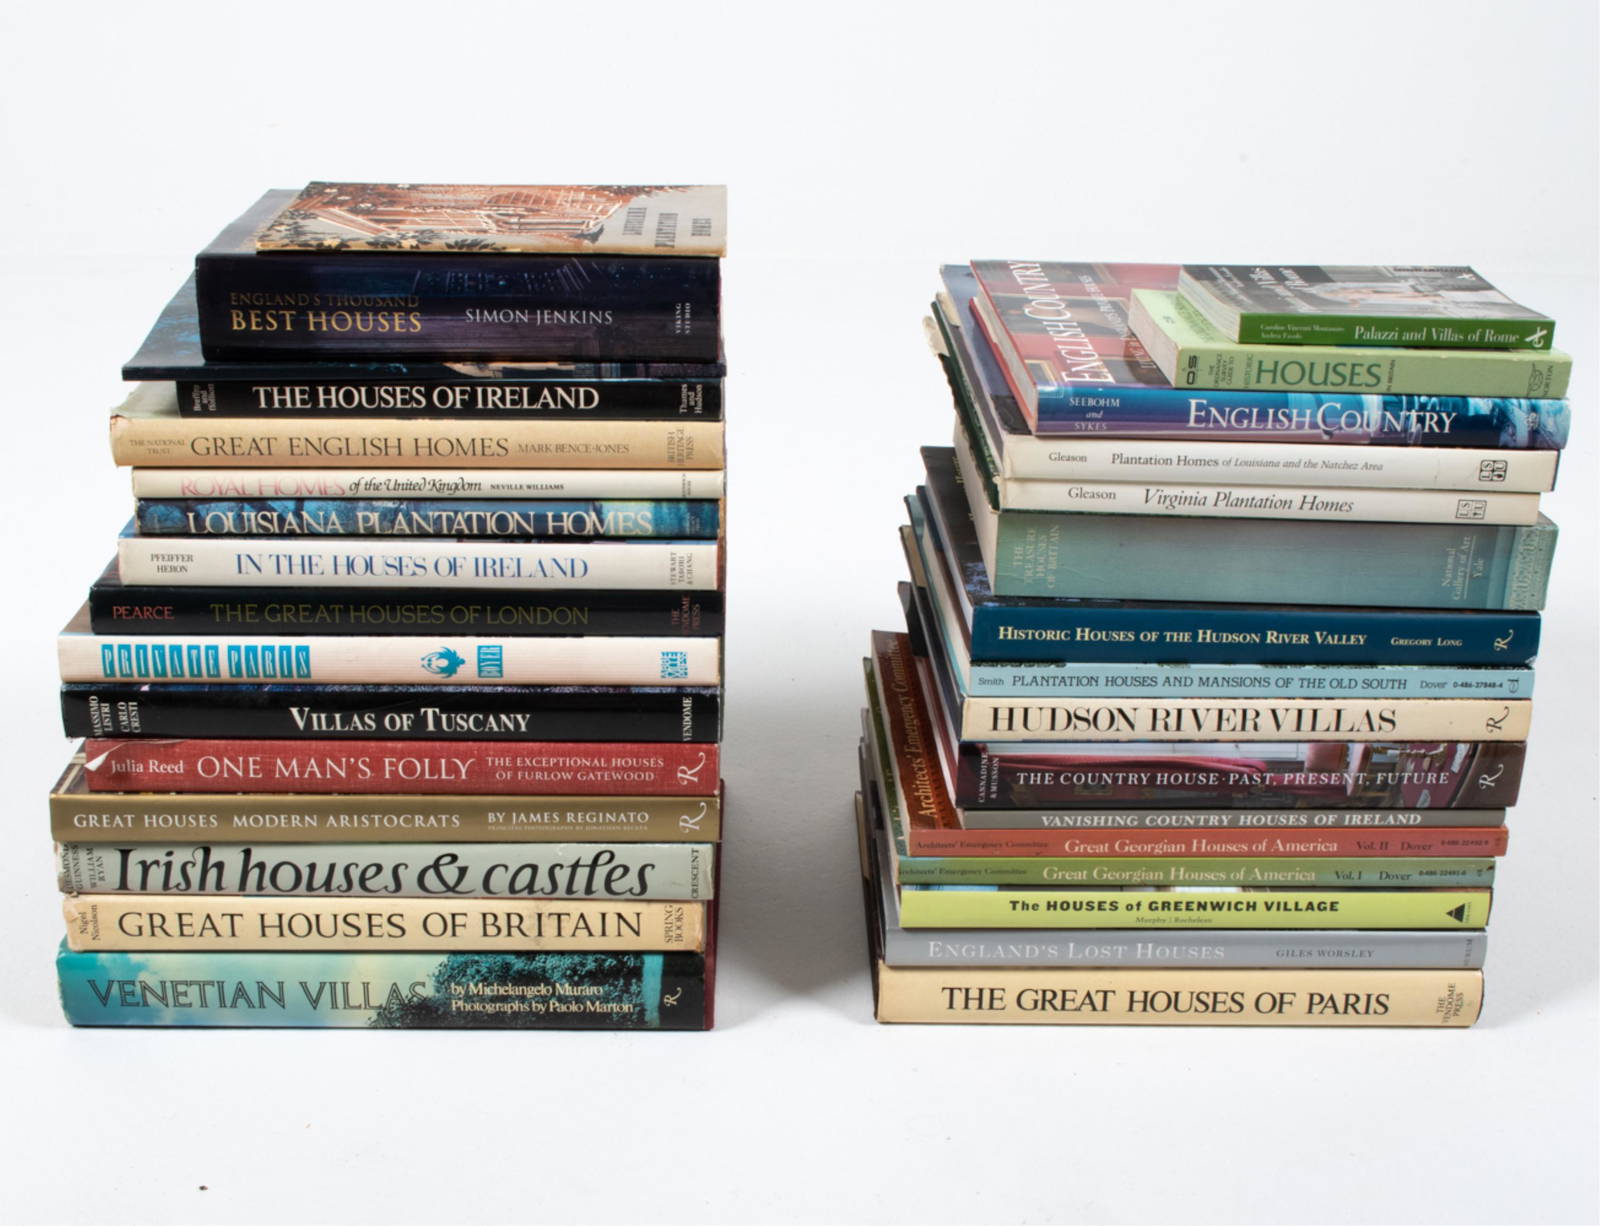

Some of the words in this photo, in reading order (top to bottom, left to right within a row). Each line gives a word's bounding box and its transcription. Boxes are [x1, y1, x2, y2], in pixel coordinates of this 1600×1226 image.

[230, 310, 297, 332] BEST
[307, 311, 422, 333] HOUSES
[465, 309, 529, 324] SIMON
[536, 310, 613, 326] JENKINS
[1354, 326, 1399, 341] Palazzi
[1402, 327, 1427, 342] and
[1431, 328, 1465, 343] Villas
[1467, 328, 1481, 343] of
[1484, 329, 1520, 344] Rome
[1255, 359, 1382, 388] HOUSES
[252, 386, 313, 409] THE
[316, 386, 427, 410] HOUSES
[432, 386, 471, 409] OF
[476, 386, 600, 410] IRELAND
[1068, 397, 1120, 408] SEEBOHM
[1086, 410, 1103, 419] and
[1187, 398, 1312, 431] ENGLISH
[1316, 402, 1457, 434] COUNTRY
[1074, 421, 1108, 431] SYKES
[191, 437, 277, 457] GREAT
[289, 437, 402, 457] ENGLISH
[413, 437, 509, 457] HOMES
[518, 443, 552, 454] MARK
[554, 443, 630, 455] BENCE-JONES
[1048, 451, 1087, 464] Gleason
[1111, 452, 1173, 466] Plantation
[1176, 454, 1220, 468] Homes
[1222, 457, 1233, 468] of
[1234, 457, 1280, 468] Louisiana
[1282, 459, 1301, 469] and
[1303, 459, 1319, 469] the
[1321, 460, 1358, 470] Natchez
[1361, 461, 1384, 471] Area
[181, 477, 249, 497] ROYAL
[257, 477, 346, 497] HOMES
[349, 477, 365, 495] of
[364, 476, 383, 492] the
[384, 476, 427, 493] United
[427, 477, 482, 496] Kingdom
[490, 483, 523, 491] NEVILLE
[526, 483, 565, 491] WILLIAMS
[1068, 486, 1117, 500] Gleason
[1143, 488, 1207, 510] Virginia
[1212, 490, 1292, 511] Plantation
[1299, 494, 1354, 513] Homes
[187, 511, 344, 535] LOUISIANA
[356, 511, 535, 535] PLANTATION
[547, 511, 653, 536] HOMES
[150, 553, 194, 562] PFEIFFER
[236, 553, 263, 575] IN
[269, 554, 325, 576] THE
[333, 555, 428, 577] HOUSES
[434, 556, 466, 577] OF
[474, 557, 588, 579] IRELAND
[157, 564, 188, 573] HERON
[112, 606, 176, 620] PEARCE
[210, 603, 260, 622] THE
[264, 604, 344, 623] GREAT
[350, 604, 446, 624] HOUSES
[450, 605, 481, 624] OF
[487, 606, 589, 625] LONDON
[998, 626, 1070, 641] HISTORIC
[1075, 628, 1135, 642] HOUSES
[1140, 631, 1159, 642] OF
[1163, 632, 1192, 643] THE
[1197, 629, 1261, 643] HUDSON
[1265, 630, 1310, 645] RIVER
[1314, 631, 1367, 645] VALLEY
[101, 644, 221, 678] PRIVATE
[227, 644, 310, 679] PARIS
[978, 677, 1004, 686] Smith
[1012, 675, 1099, 687] PLANTATION
[1105, 675, 1158, 687] HOUSES
[1162, 676, 1193, 688] AND
[1198, 677, 1271, 689] MANSIONS
[1274, 678, 1293, 688] OF
[1299, 678, 1326, 689] THE
[1329, 679, 1358, 690] OLD
[1361, 679, 1407, 690] SOUTH
[1420, 680, 1447, 690] Dover
[117, 702, 130, 733] CARLO
[128, 702, 141, 733] CRESTI
[289, 707, 376, 731] VILLAS
[384, 713, 414, 732] OF
[421, 708, 530, 732] TUSCANY
[682, 697, 692, 742] VENDOME
[988, 706, 1138, 733] HUDSON
[1147, 707, 1260, 733] RIVER
[1269, 707, 1397, 734] VILLAS
[111, 760, 144, 774] Julia
[150, 760, 184, 773] Reed
[197, 756, 263, 778] ONE
[275, 757, 371, 779] MAN'S
[383, 758, 476, 780] FOLLY
[486, 757, 512, 767] THE
[517, 757, 607, 768] EXCEPTIONAL
[611, 758, 665, 768] HOUSES
[496, 771, 513, 781] OF
[518, 771, 573, 781] FURLOW
[577, 772, 655, 782] GATEWOOD
[1017, 772, 1055, 785] THE
[1060, 772, 1151, 786] COUNTRY
[1283, 773, 1371, 787] PRESENT,
[1376, 772, 1449, 785] FUTURE
[74, 813, 135, 828] GREAT
[144, 813, 218, 828] HOUSES
[233, 813, 317, 828] MODERN
[326, 814, 460, 829] ARISTOCRATS
[488, 811, 506, 824] BY
[512, 811, 561, 825] JAMES
[567, 812, 649, 824] REGINATO
[1041, 815, 1139, 827] VANISHING
[1145, 815, 1232, 827] COUNTRY
[1239, 814, 1308, 827] HOUSES
[1314, 814, 1338, 826] OF
[1344, 813, 1422, 826] IRELAND
[1064, 839, 1109, 853] Great
[1114, 839, 1186, 855] Georgian
[1191, 839, 1249, 853] Houses
[1252, 838, 1268, 852] of
[1271, 838, 1338, 852] America
[112, 845, 228, 893] Irish
[237, 847, 409, 894] houses
[417, 853, 476, 895] &
[482, 849, 656, 897] castles
[691, 848, 700, 899] CRESCENT
[1042, 866, 1087, 881] Great
[1093, 866, 1163, 883] Georgian
[1170, 867, 1226, 881] Houses
[1230, 867, 1246, 881] of
[1250, 867, 1316, 882] America
[1009, 900, 1040, 912] The
[1046, 900, 1119, 912] HOUSES
[1125, 900, 1142, 912] of
[1148, 900, 1258, 912] GREENWICH
[1264, 901, 1340, 912] VILLAGE
[118, 911, 244, 938] GREAT
[259, 912, 407, 938] HOUSES
[422, 912, 468, 938] OF
[480, 911, 642, 938] BRITAIN
[928, 940, 1058, 959] ENGLAND'S
[1068, 942, 1127, 959] LOST
[1135, 942, 1225, 960] HOUSES
[1275, 949, 1313, 958] GILES
[1317, 949, 1376, 959] WORSLEY
[86, 979, 286, 1009] VENETIAN
[298, 981, 427, 1011] VILLAS
[451, 982, 467, 997] by
[468, 982, 553, 998] Michelangelo
[555, 983, 604, 996] Muraro
[451, 1000, 530, 1015] Photographs
[532, 1000, 547, 1014] by
[549, 1001, 584, 1013] Paolo
[586, 1001, 634, 1014] Marton
[941, 987, 1007, 1011] THE
[1016, 988, 1116, 1013] GREAT
[1127, 990, 1245, 1015] HOUSES
[1254, 991, 1297, 1015] OF
[1305, 992, 1390, 1016] PARIS
